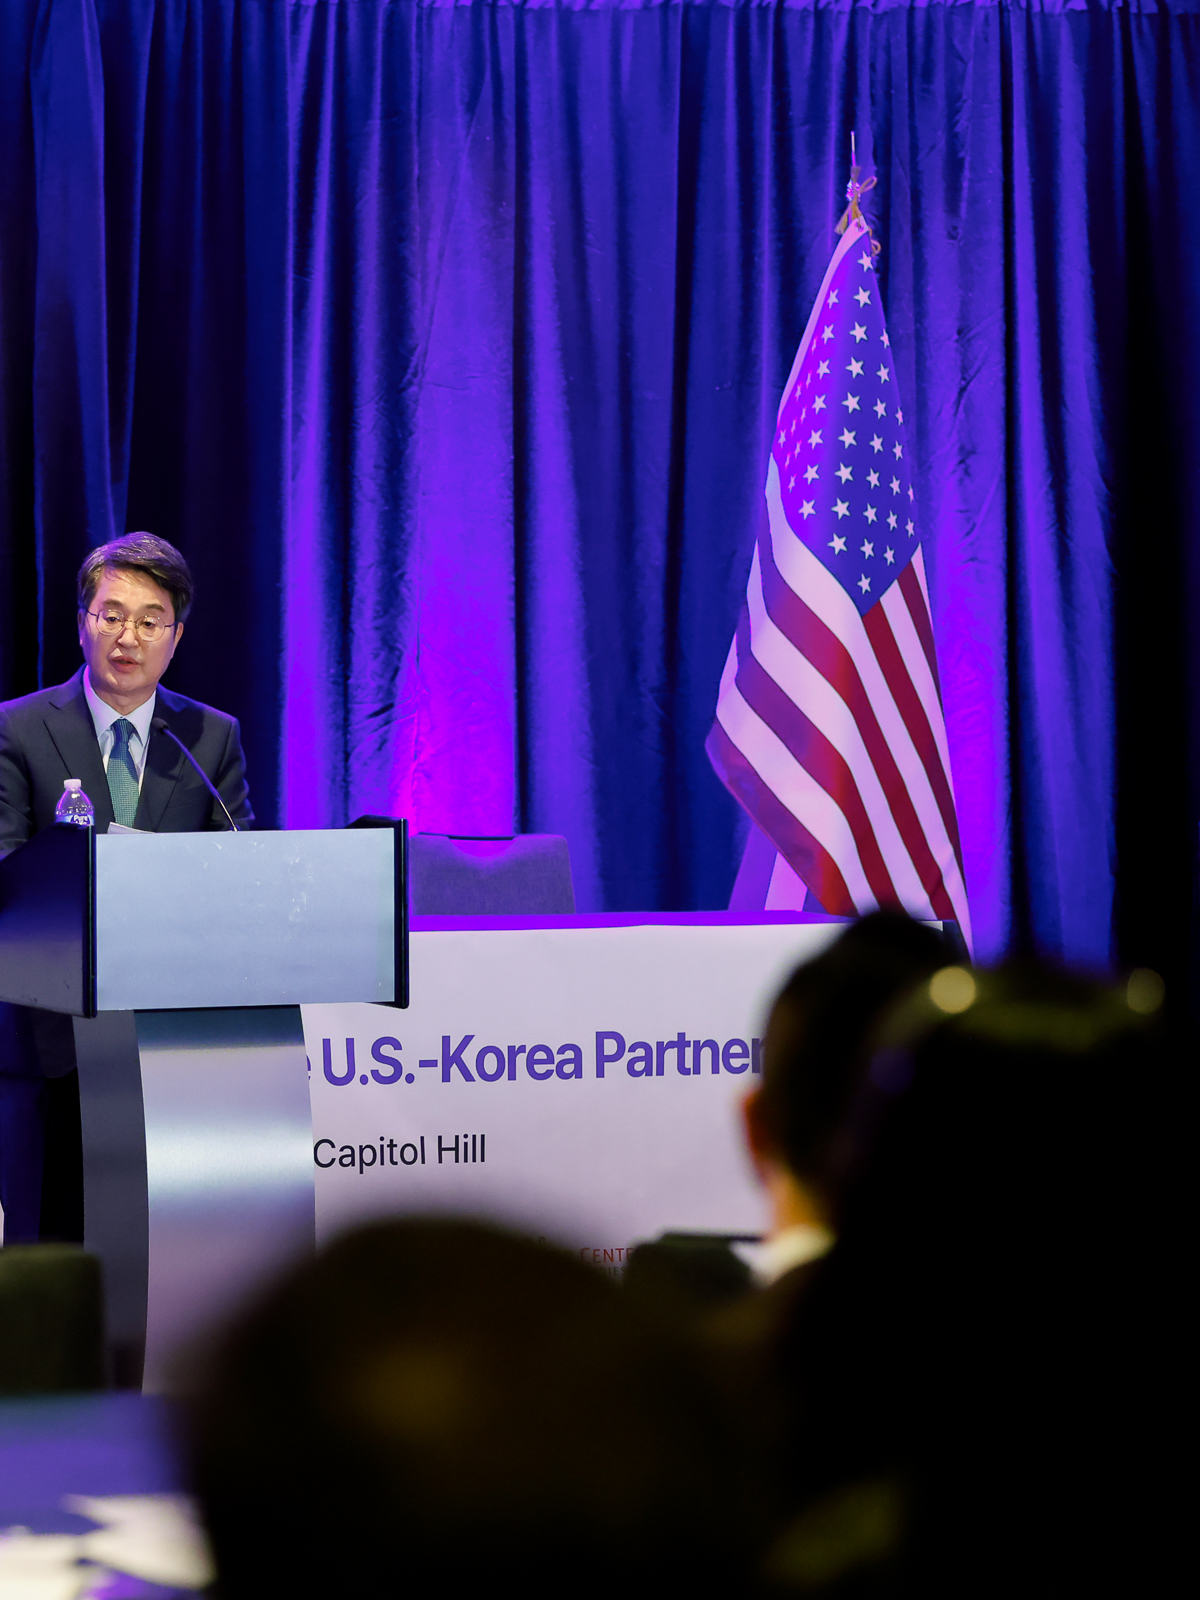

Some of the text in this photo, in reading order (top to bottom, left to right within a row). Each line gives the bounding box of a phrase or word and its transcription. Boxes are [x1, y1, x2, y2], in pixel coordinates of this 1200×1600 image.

[322, 1035, 583, 1087] U.S.-Korea
[313, 1133, 486, 1175] Capitol Hill
